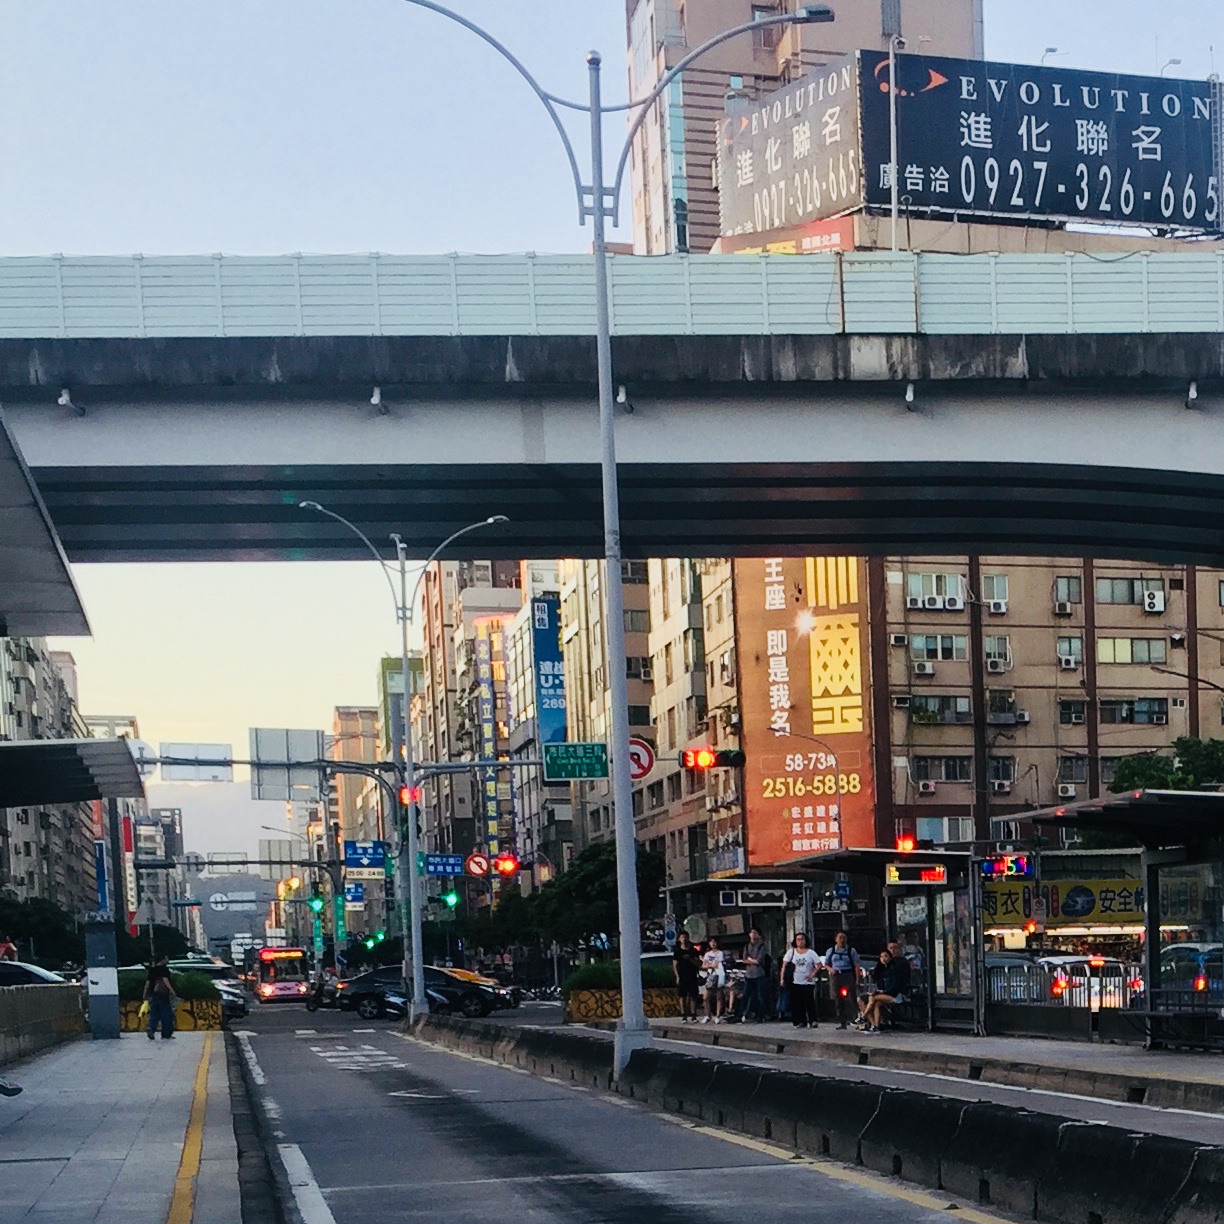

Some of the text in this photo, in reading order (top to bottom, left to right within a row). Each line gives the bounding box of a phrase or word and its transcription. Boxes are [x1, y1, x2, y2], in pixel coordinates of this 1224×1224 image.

[751, 64, 852, 136] EVOLUTION
[958, 75, 1213, 121] EVOLUTION
[736, 105, 841, 188] 進化聯名
[959, 110, 1162, 162] 進化聯名
[754, 149, 857, 232] 0927-326-665
[879, 155, 1219, 222] 廣告洽 0927-326-665
[766, 629, 791, 737] 即是我名
[762, 773, 862, 798] 2516-5888
